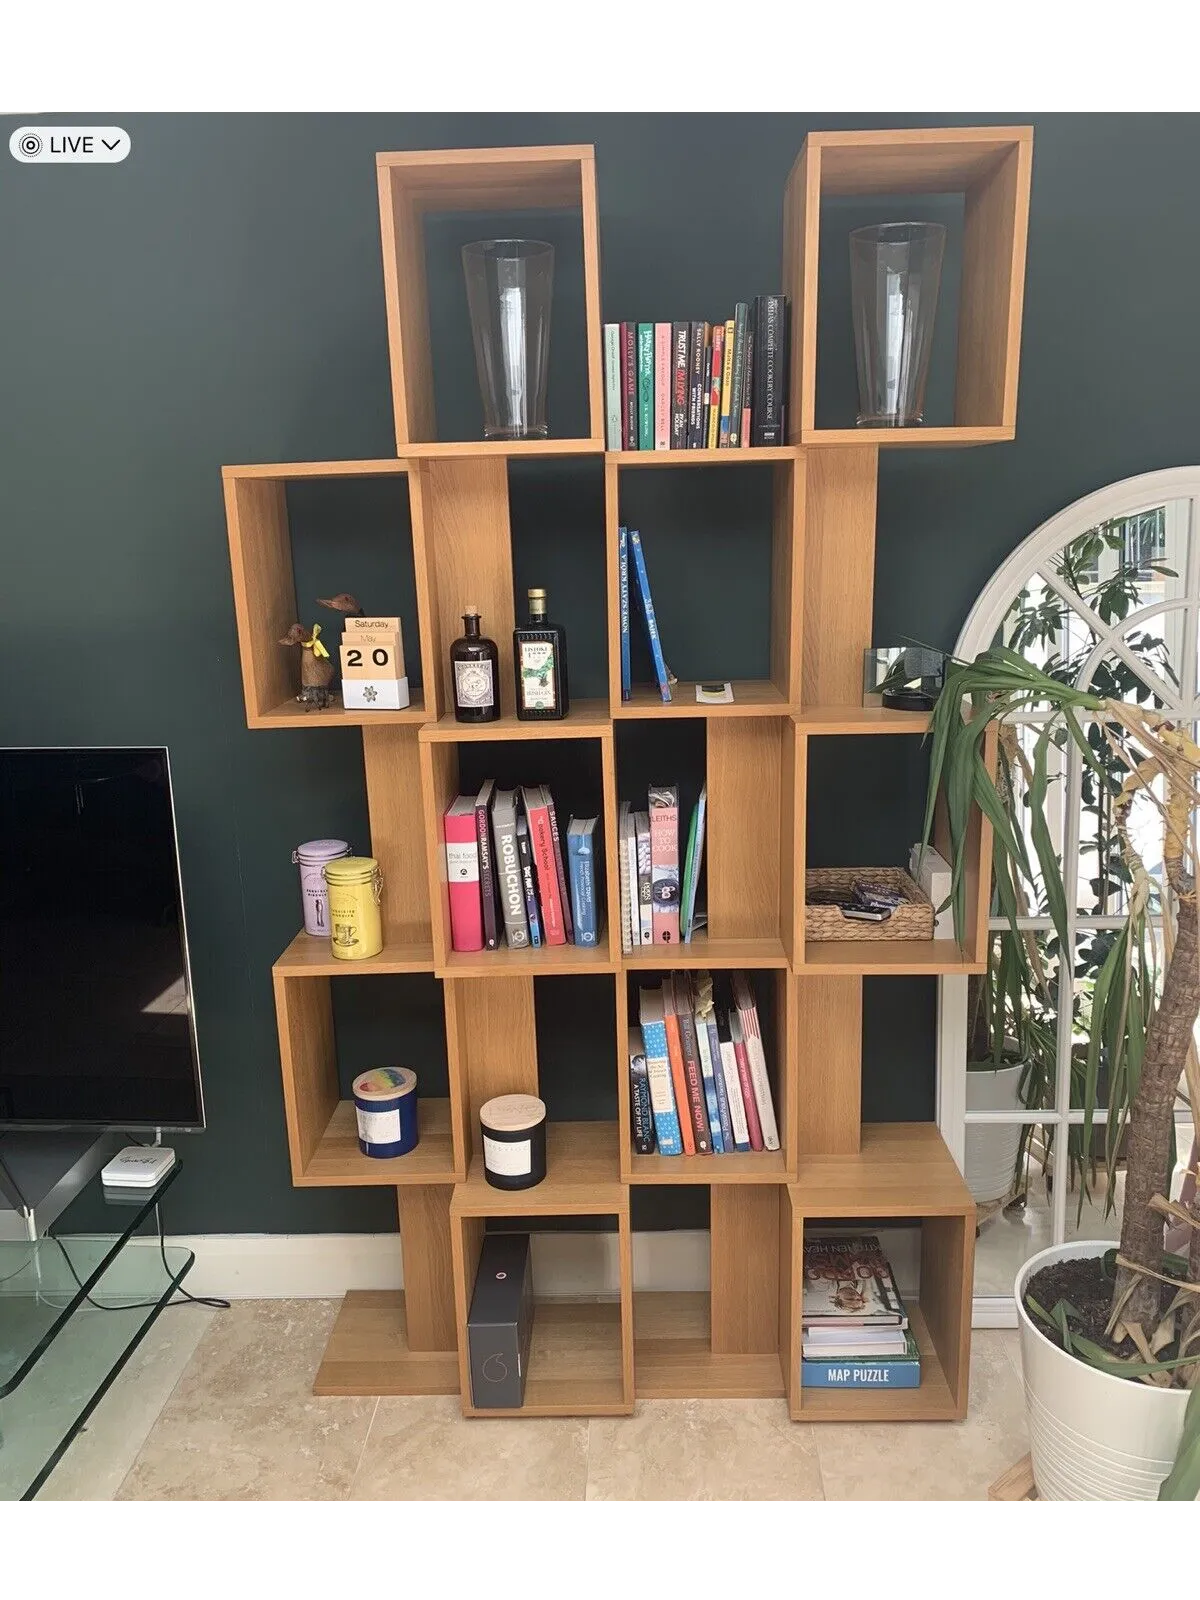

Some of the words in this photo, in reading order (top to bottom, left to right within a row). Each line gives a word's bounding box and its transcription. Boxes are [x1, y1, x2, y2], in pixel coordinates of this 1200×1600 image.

[678, 330, 686, 353] TRUST
[677, 381, 685, 406] LYING
[354, 619, 389, 629] Saturday
[360, 634, 377, 643] May
[479, 809, 487, 837] GORDON
[538, 819, 548, 848] Cookery
[549, 810, 559, 842] SAUCES
[480, 836, 490, 870] RAMSAY'S
[541, 848, 550, 871] School
[501, 834, 522, 916] ROBUCHON
[687, 1060, 698, 1086] FEED
[639, 1077, 648, 1116] RAYMOND
[691, 1087, 701, 1104] ME
[635, 1108, 641, 1116] OF
[635, 1117, 641, 1126] MY
[694, 1105, 704, 1132] NOW!
[641, 1116, 650, 1143] BLANC
[828, 1369, 850, 1382] MAP
[853, 1369, 889, 1382] PUZZLE
